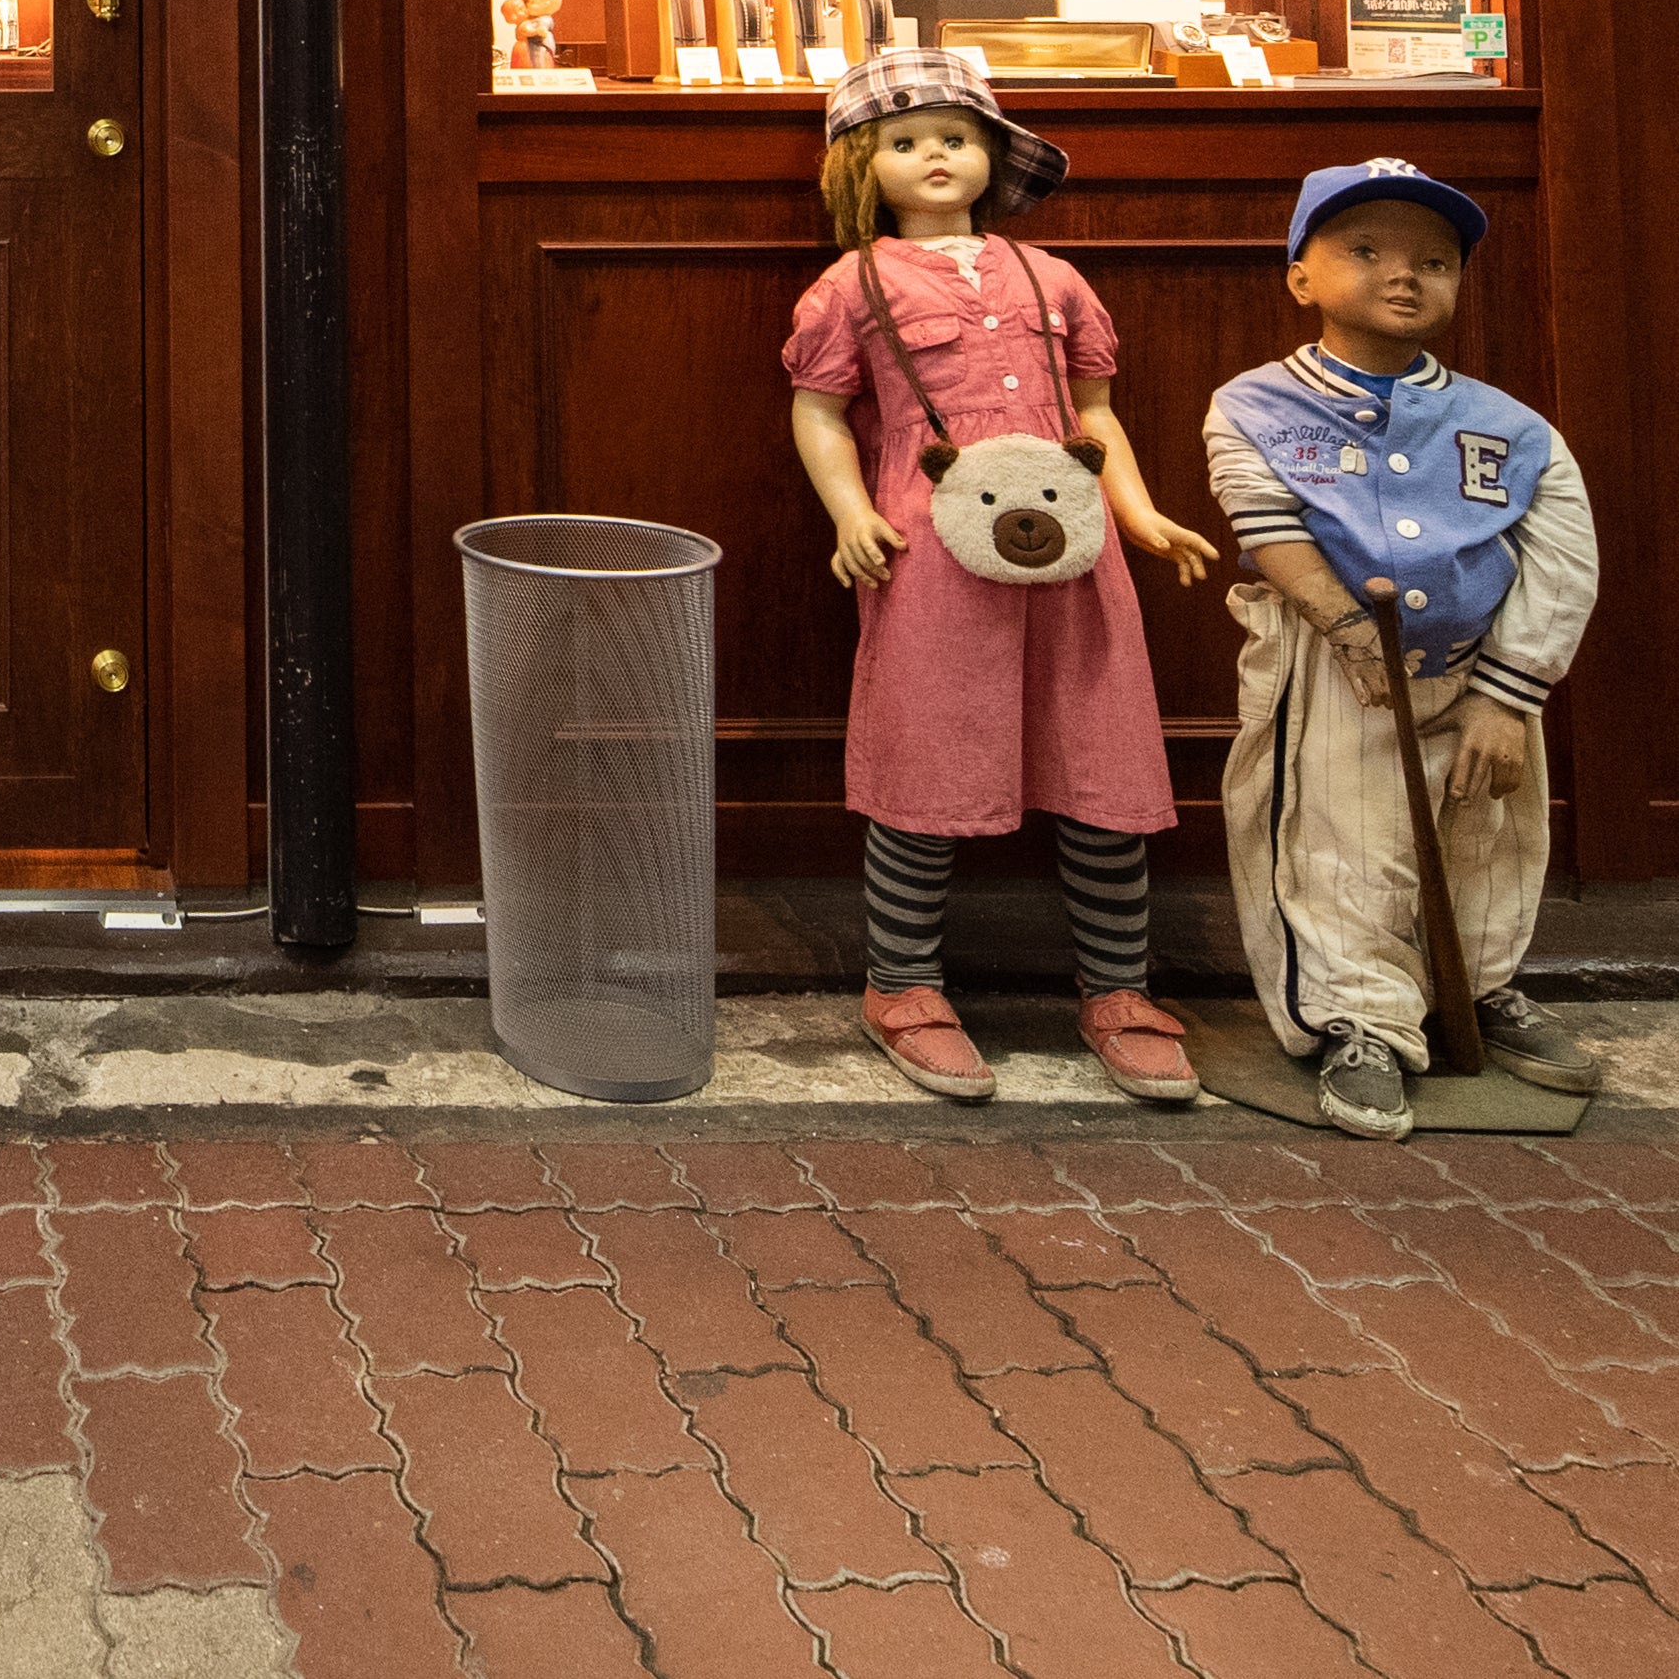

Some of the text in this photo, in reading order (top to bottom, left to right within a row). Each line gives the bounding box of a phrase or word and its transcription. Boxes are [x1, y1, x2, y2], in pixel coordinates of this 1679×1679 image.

[1289, 425, 1348, 452] Villag
[1292, 444, 1319, 461] 35
[1454, 429, 1510, 510] E
